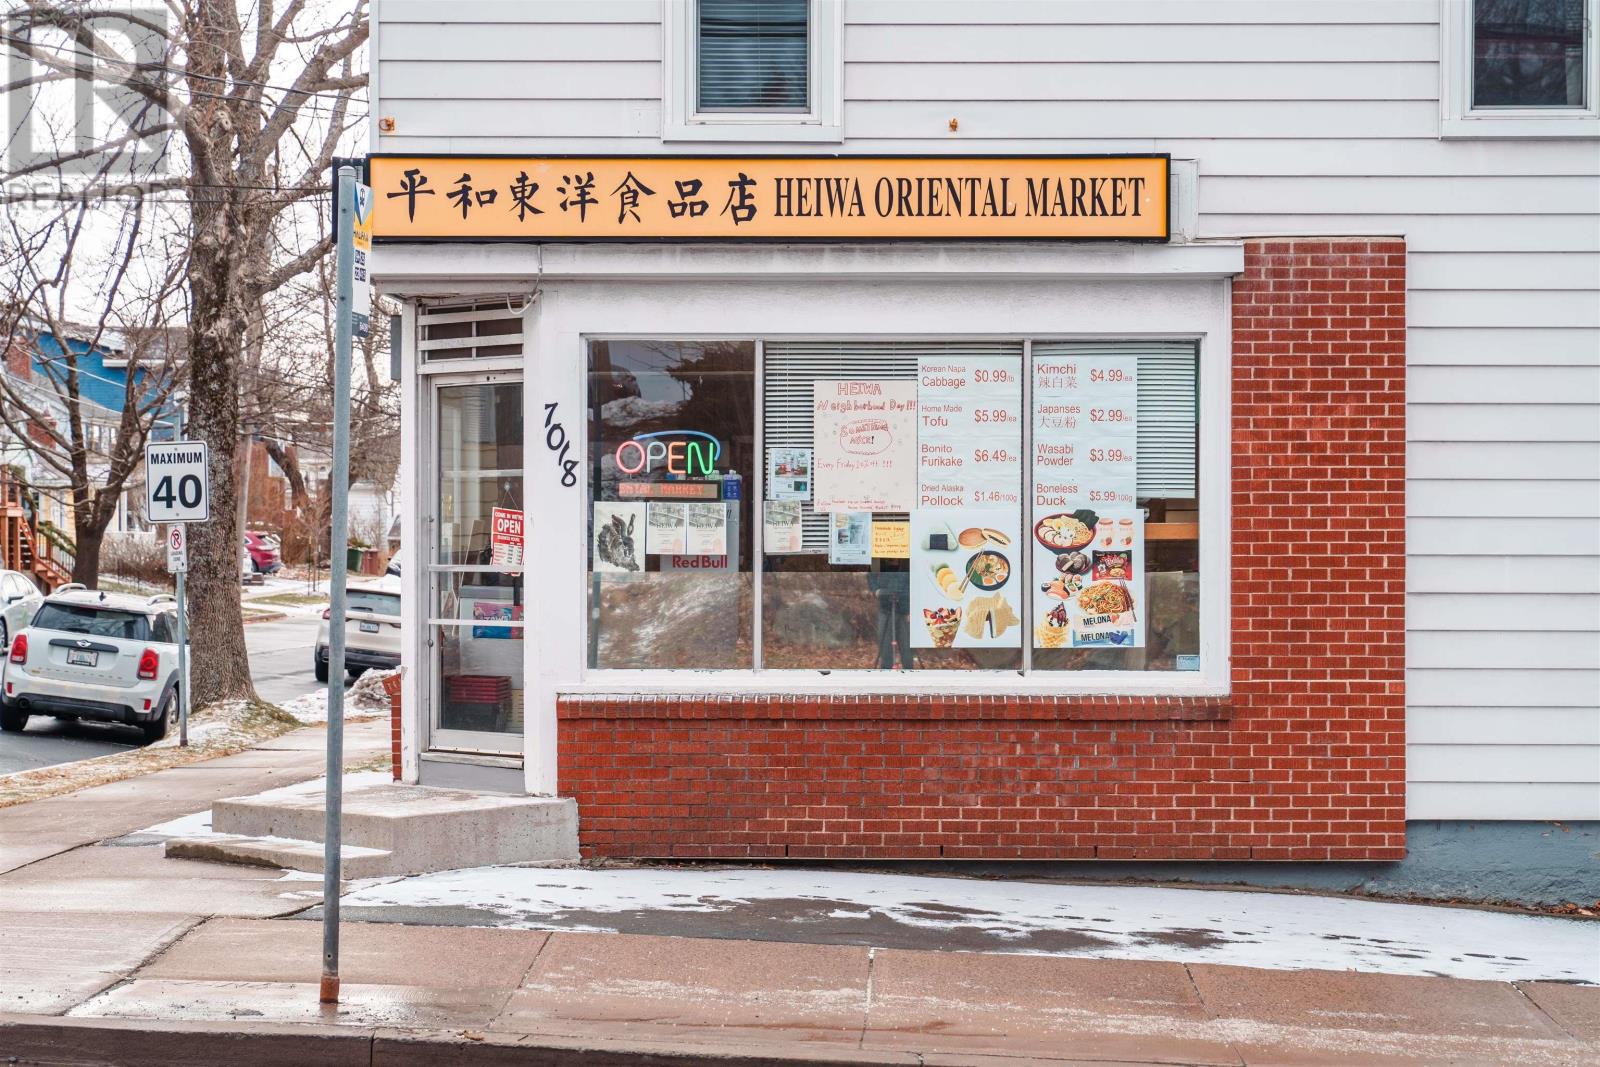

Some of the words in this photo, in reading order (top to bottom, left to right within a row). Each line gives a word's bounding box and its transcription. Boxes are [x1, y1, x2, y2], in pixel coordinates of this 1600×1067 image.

[387, 168, 757, 226] 平和東洋食品店
[774, 177, 865, 217] HEIWA
[874, 177, 1016, 217] ORIENTAL
[1025, 177, 1145, 217] MARKET
[921, 365, 946, 373] Korean
[948, 365, 966, 374] Napa
[1037, 363, 1076, 375] Kimchi
[922, 376, 966, 389] Cabbage
[838, 382, 882, 396] HEIWA
[1038, 404, 1080, 415] Japanses
[923, 416, 948, 427] Tofu
[545, 402, 579, 487] 7018
[921, 444, 953, 453] Bonito
[1037, 443, 1074, 454] Wasabi
[151, 452, 203, 465] MAXIMUM
[615, 440, 715, 475] OPEN
[921, 455, 963, 467] Furikake
[1037, 455, 1073, 466] Powder
[153, 474, 203, 509] 40
[921, 484, 940, 492] Dried
[941, 484, 964, 492] Alaska
[1037, 484, 1078, 494] Boneless
[921, 495, 964, 506] Pollock
[1037, 495, 1067, 506] Duck
[497, 518, 521, 535] OPEN
[672, 555, 699, 569] Red
[702, 555, 728, 569] Bull
[1083, 614, 1112, 626] MELONA
[1081, 631, 1112, 642] MELONA
